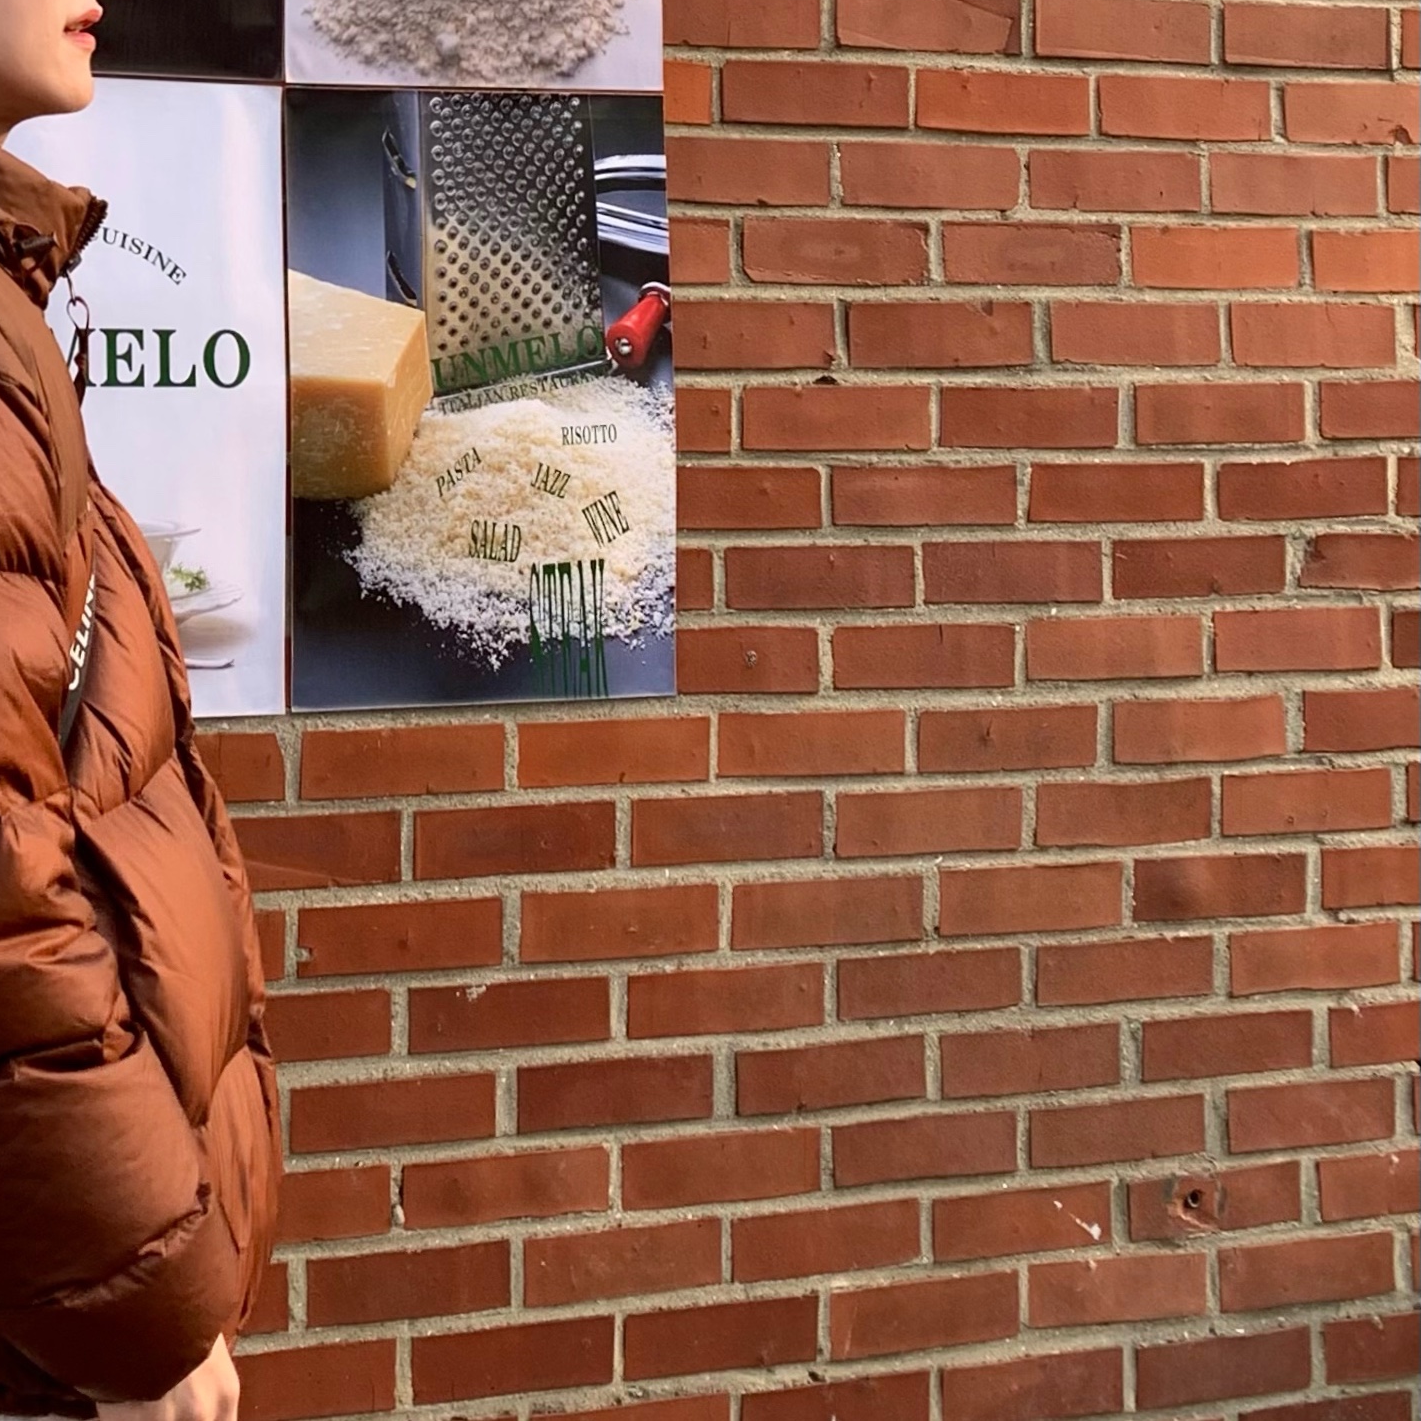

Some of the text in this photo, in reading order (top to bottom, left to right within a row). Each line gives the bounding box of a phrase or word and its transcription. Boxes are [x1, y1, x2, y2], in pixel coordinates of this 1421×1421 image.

[93, 226, 188, 286] UISINE
[430, 325, 604, 391] UNMELO
[560, 423, 618, 446] RISOTTO
[435, 446, 482, 497] PASTA
[530, 462, 572, 499] JAZZ
[468, 519, 523, 563] SALAD
[581, 490, 631, 550] WINE
